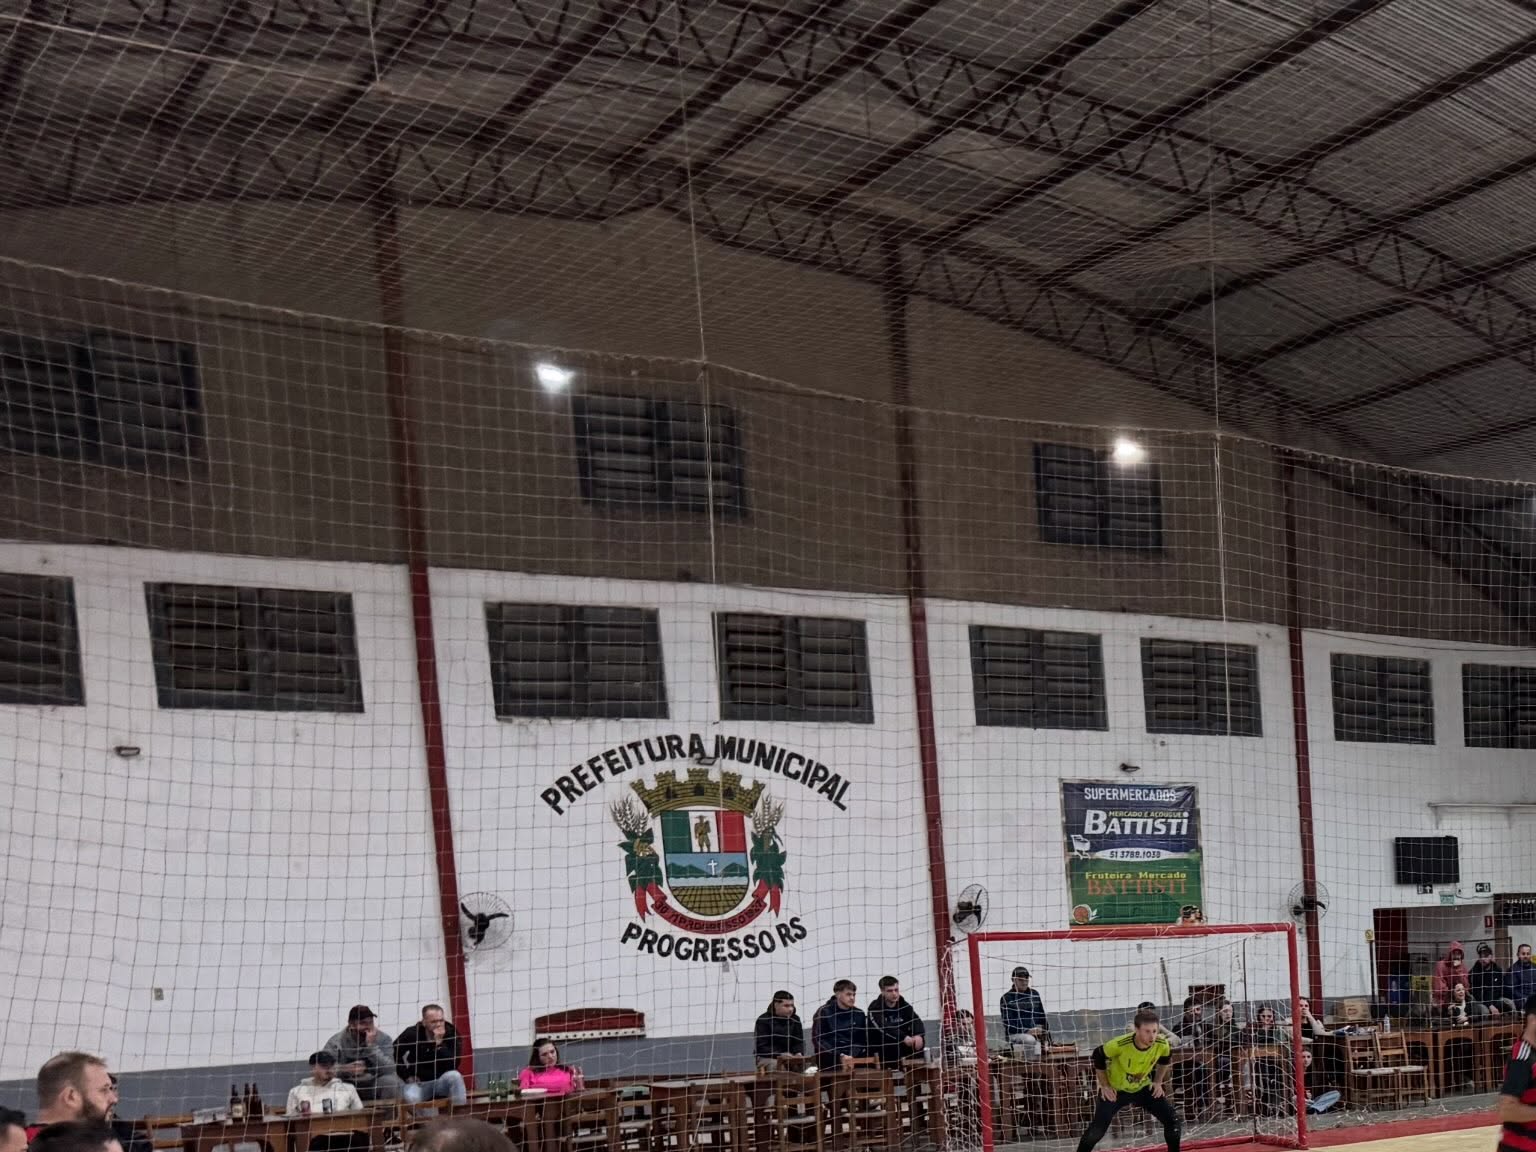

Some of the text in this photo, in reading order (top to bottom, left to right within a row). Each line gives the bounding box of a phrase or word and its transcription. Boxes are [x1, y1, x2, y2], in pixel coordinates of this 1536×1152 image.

[540, 733, 850, 816] PREFEITURA MUNICIPAL
[1084, 787, 1177, 802] SUPERMERCADOS
[1085, 871, 1187, 880] Fruteira Mercado
[1088, 879, 1187, 895] BATTISTI
[620, 916, 807, 963] PROGRESSO RS
